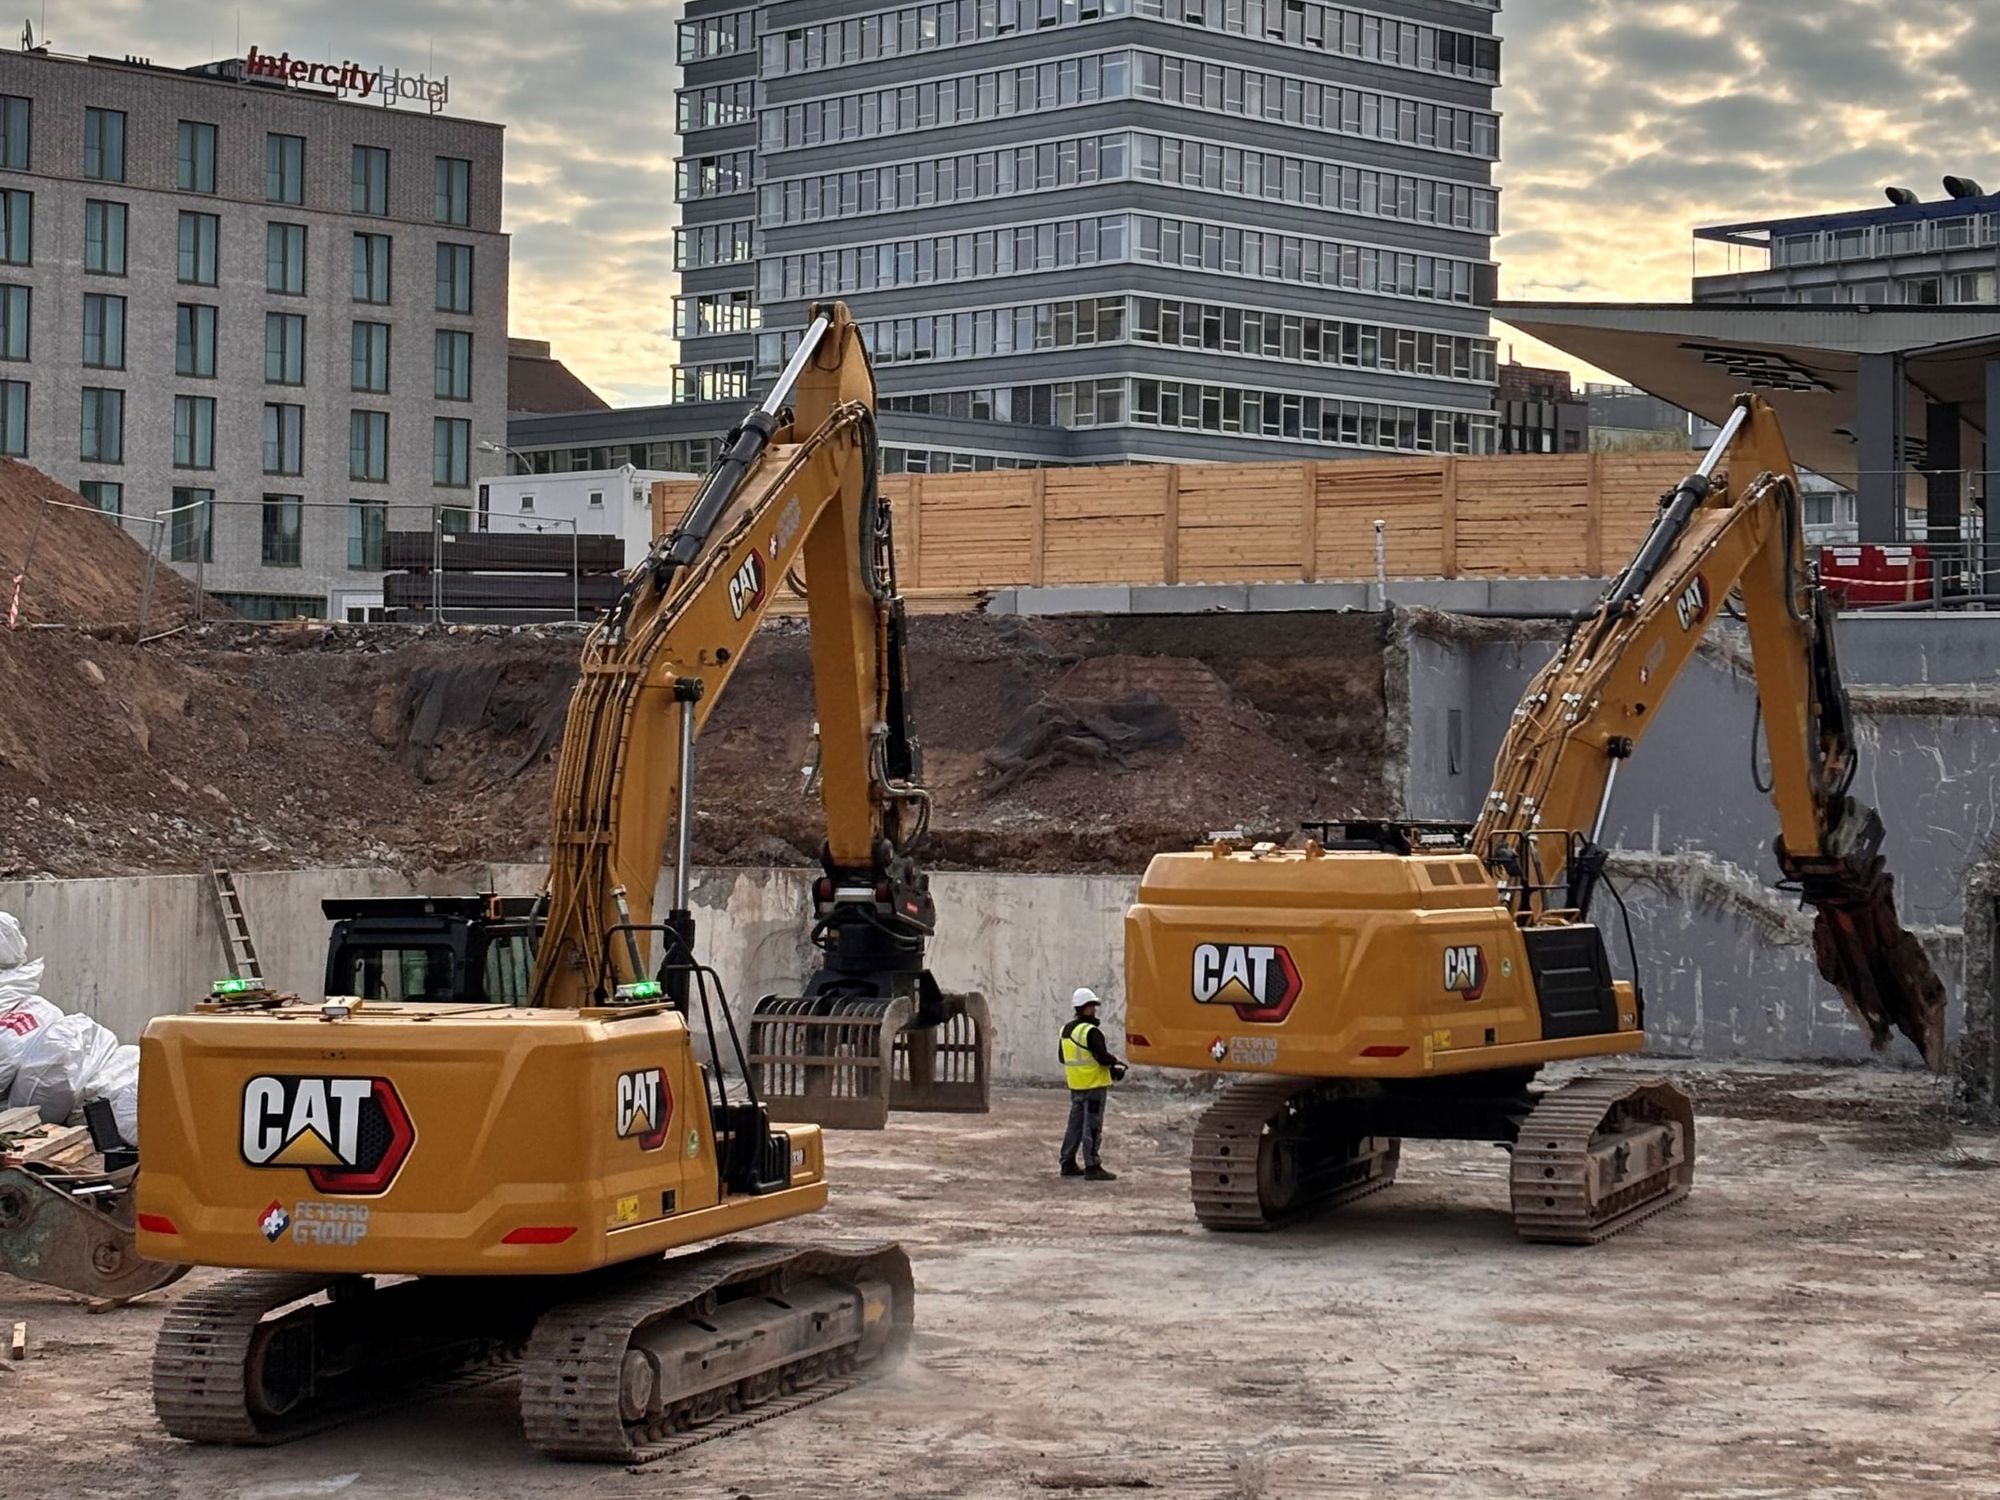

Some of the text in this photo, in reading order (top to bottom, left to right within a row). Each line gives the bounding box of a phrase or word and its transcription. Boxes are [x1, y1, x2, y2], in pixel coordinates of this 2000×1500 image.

[729, 552, 758, 620] CAT
[1676, 576, 1703, 631] CAT
[1193, 944, 1275, 1004] CAT
[1444, 947, 1478, 991] CAT
[243, 1076, 372, 1166] CAT
[617, 1069, 660, 1137] CAT
[292, 1219, 368, 1245] GROUP
